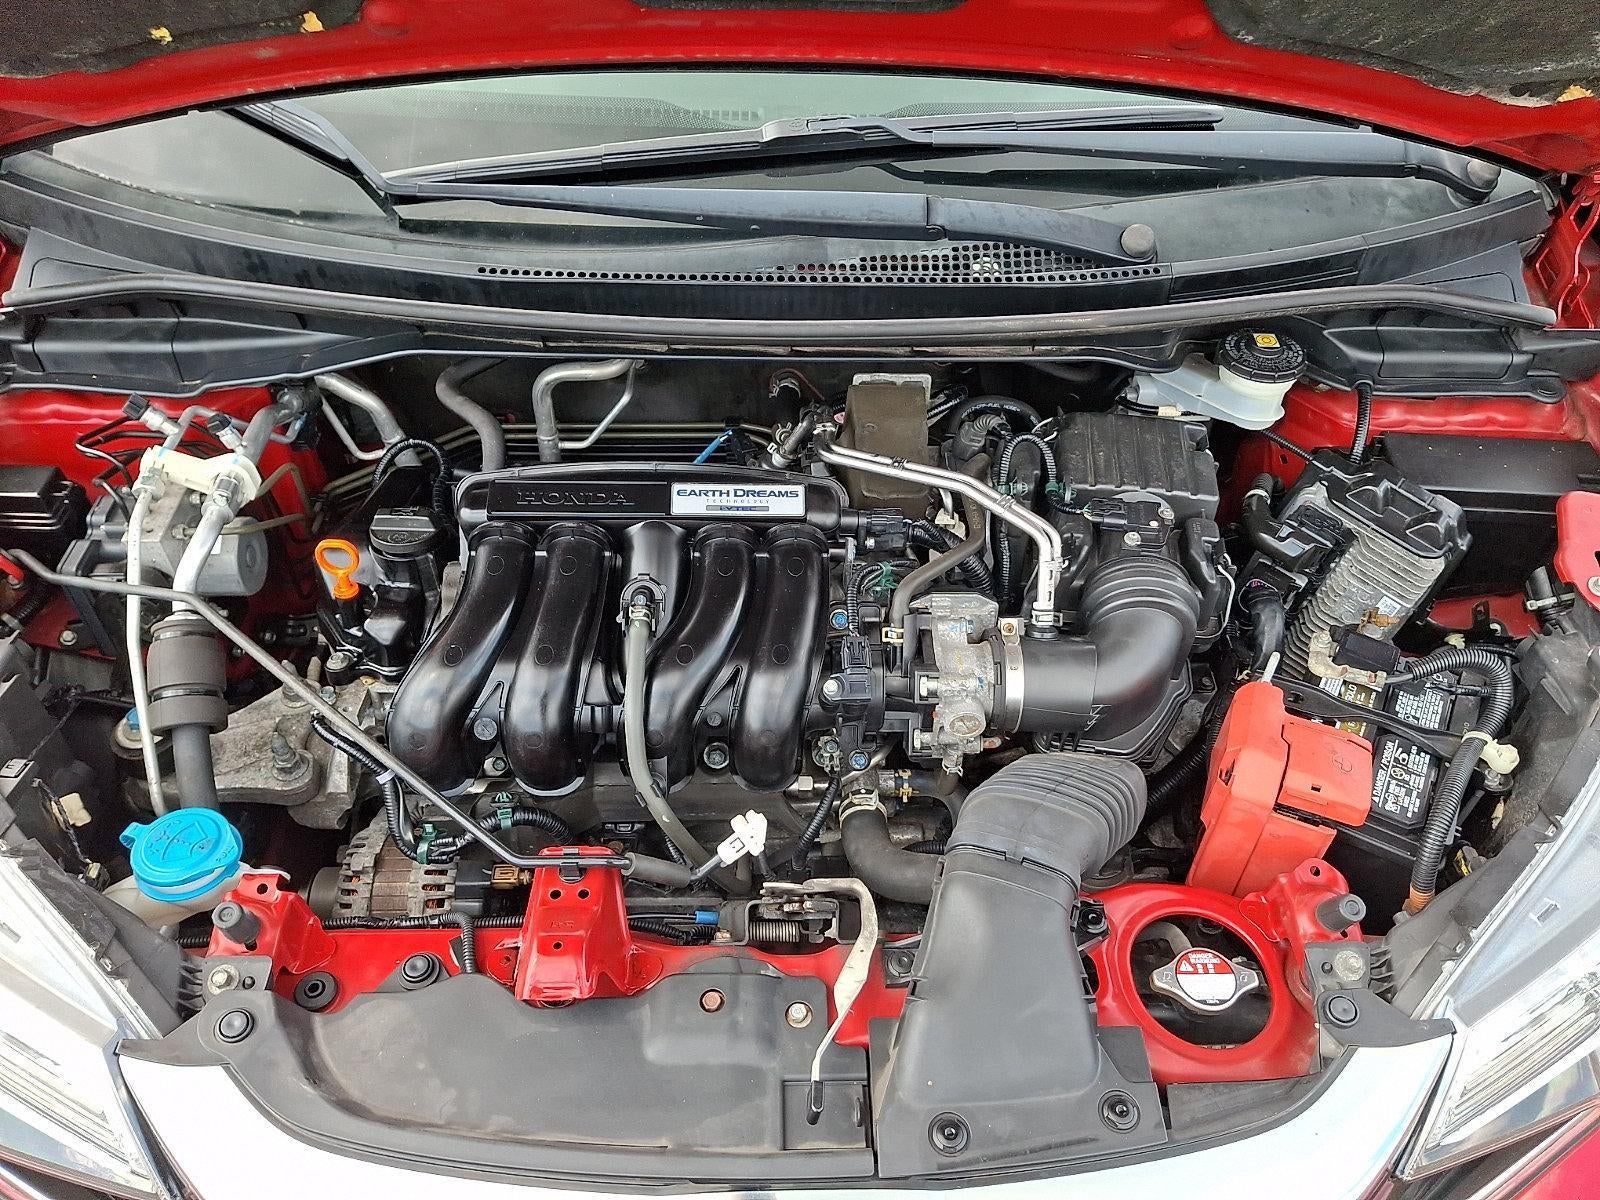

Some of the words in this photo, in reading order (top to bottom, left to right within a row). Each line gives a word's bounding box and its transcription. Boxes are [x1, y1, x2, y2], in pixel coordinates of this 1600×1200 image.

[516, 490, 635, 505] HONDA
[676, 488, 730, 497] EARTH
[733, 487, 799, 498] DREAMS
[1373, 769, 1386, 797] DANGER
[1381, 741, 1394, 764] POISON
